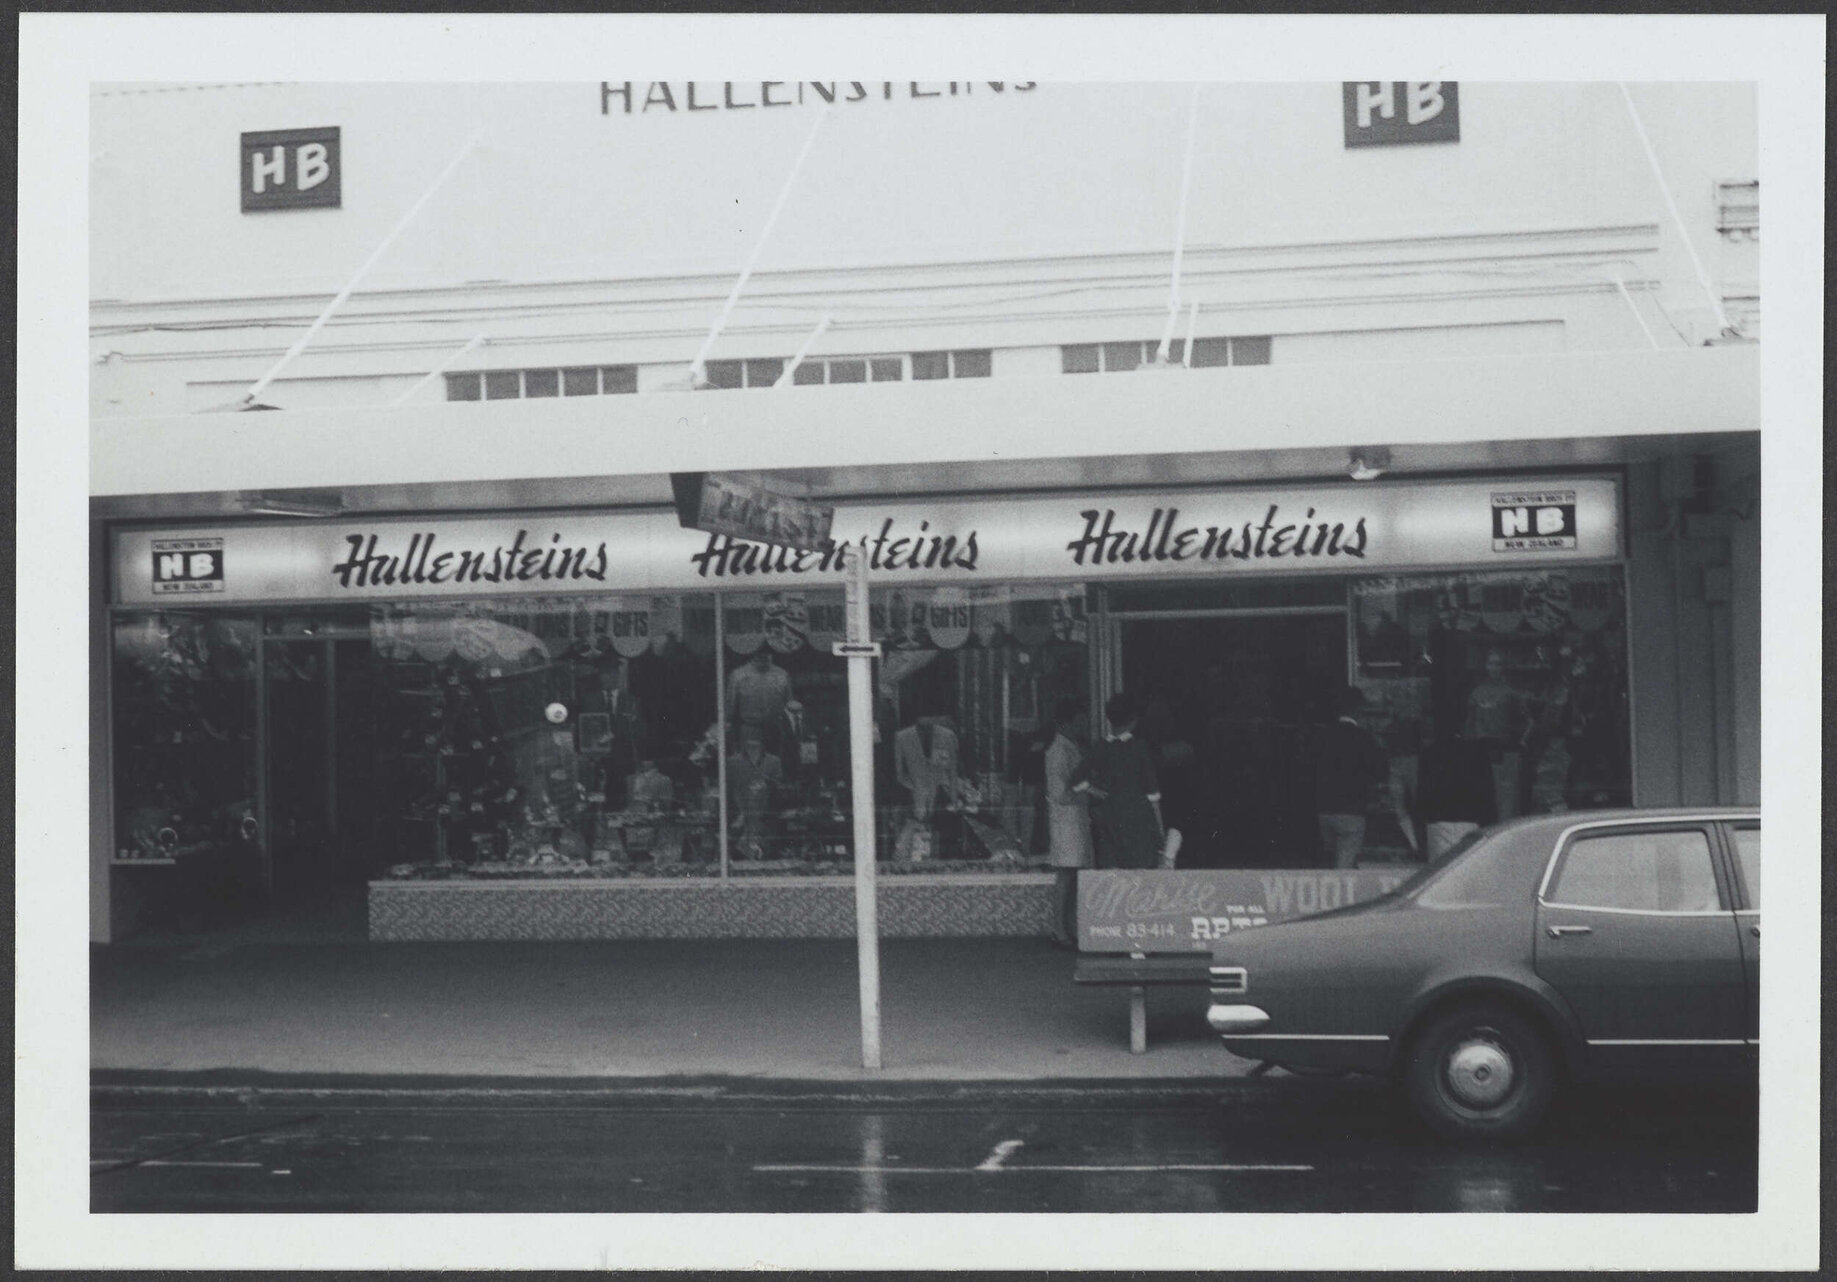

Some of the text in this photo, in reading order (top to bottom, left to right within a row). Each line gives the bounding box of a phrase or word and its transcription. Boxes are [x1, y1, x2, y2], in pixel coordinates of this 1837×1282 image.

[600, 81, 1037, 115] HALLEN
[1357, 81, 1444, 128] HB
[253, 142, 330, 193] HB
[1066, 504, 1366, 565] Hallensteins
[1501, 507, 1564, 537] HB
[160, 553, 214, 580] HB
[332, 529, 607, 588] Hallensteins
[692, 518, 978, 577] Haenteins
[1089, 925, 1122, 937] PHONE
